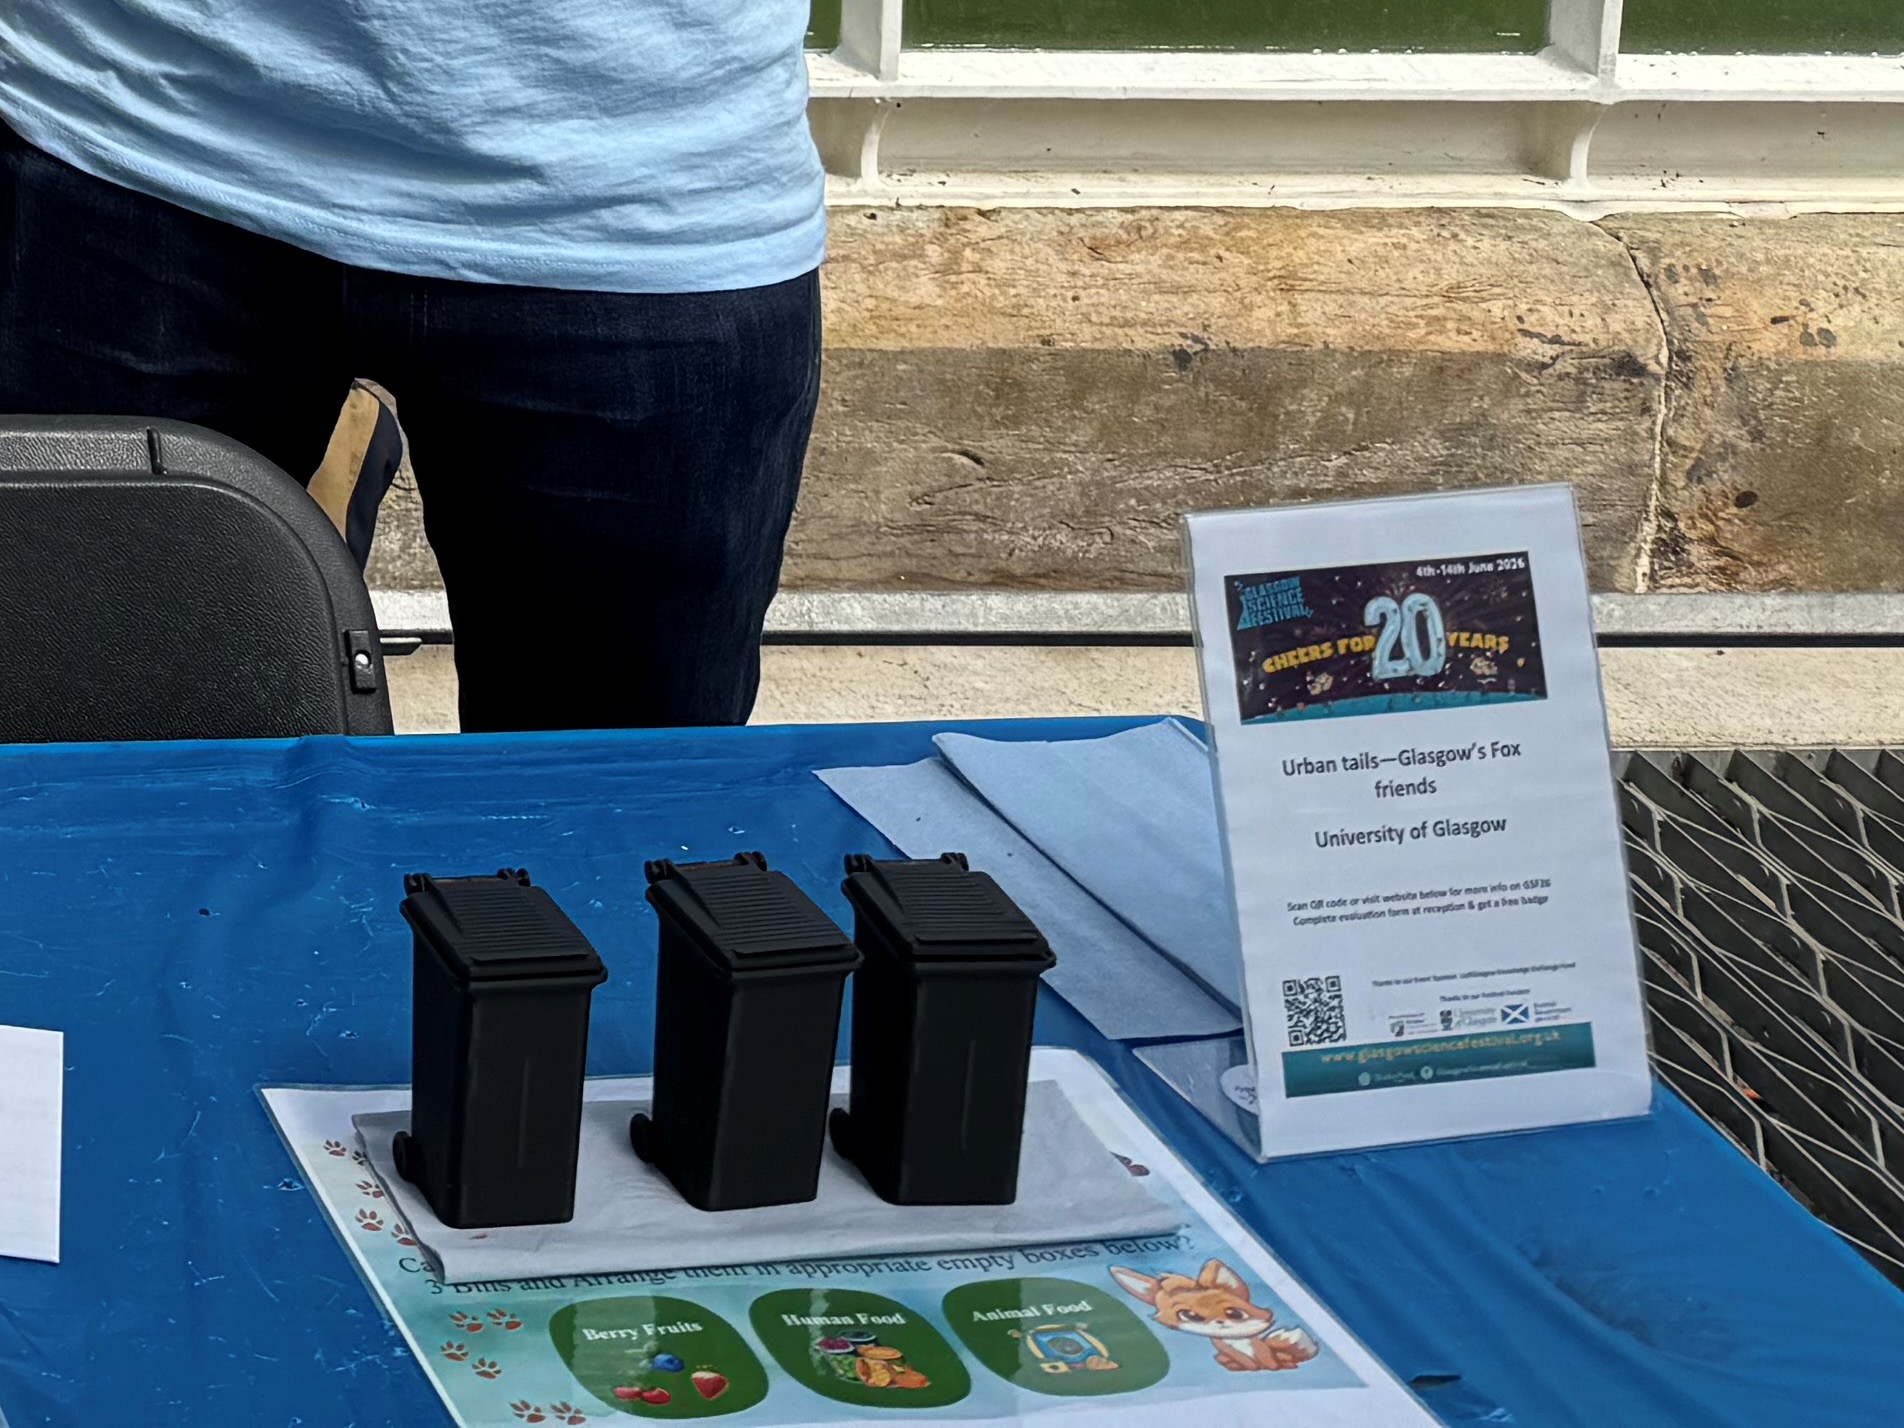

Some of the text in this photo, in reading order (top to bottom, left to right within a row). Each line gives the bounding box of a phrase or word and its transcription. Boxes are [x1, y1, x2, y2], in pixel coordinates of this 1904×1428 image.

[1468, 562, 1494, 575] June
[1245, 576, 1301, 599] GLASGOW
[1248, 594, 1304, 612] SCIENCE
[1250, 606, 1306, 627] FESTIVAL
[1263, 593, 1509, 680] CHEERS FOR 20 YEARS
[1282, 757, 1337, 776] Urban
[1491, 741, 1522, 759] Fox
[1375, 777, 1437, 798] friends
[1315, 818, 1507, 848] University of Glasgow
[1287, 902, 1308, 912] Scan
[1326, 897, 1347, 908] code
[1383, 891, 1417, 903] website
[1419, 889, 1447, 900] below
[1465, 885, 1487, 895] more
[1490, 882, 1508, 893] info
[1510, 882, 1521, 891] on
[1293, 915, 1337, 926] Complete
[1339, 909, 1386, 922] evaluation
[1388, 907, 1410, 918] form
[1423, 902, 1465, 915] reception
[425, 1279, 443, 1295] 3
[788, 1257, 929, 1278] appropriate
[936, 1252, 1015, 1273] empty
[1022, 1243, 1099, 1264] boxes
[1101, 1234, 1195, 1256] below?
[781, 1310, 907, 1328] Human Food
[973, 1300, 1093, 1322] Animal Food
[582, 1319, 704, 1344] Berry Fruits
